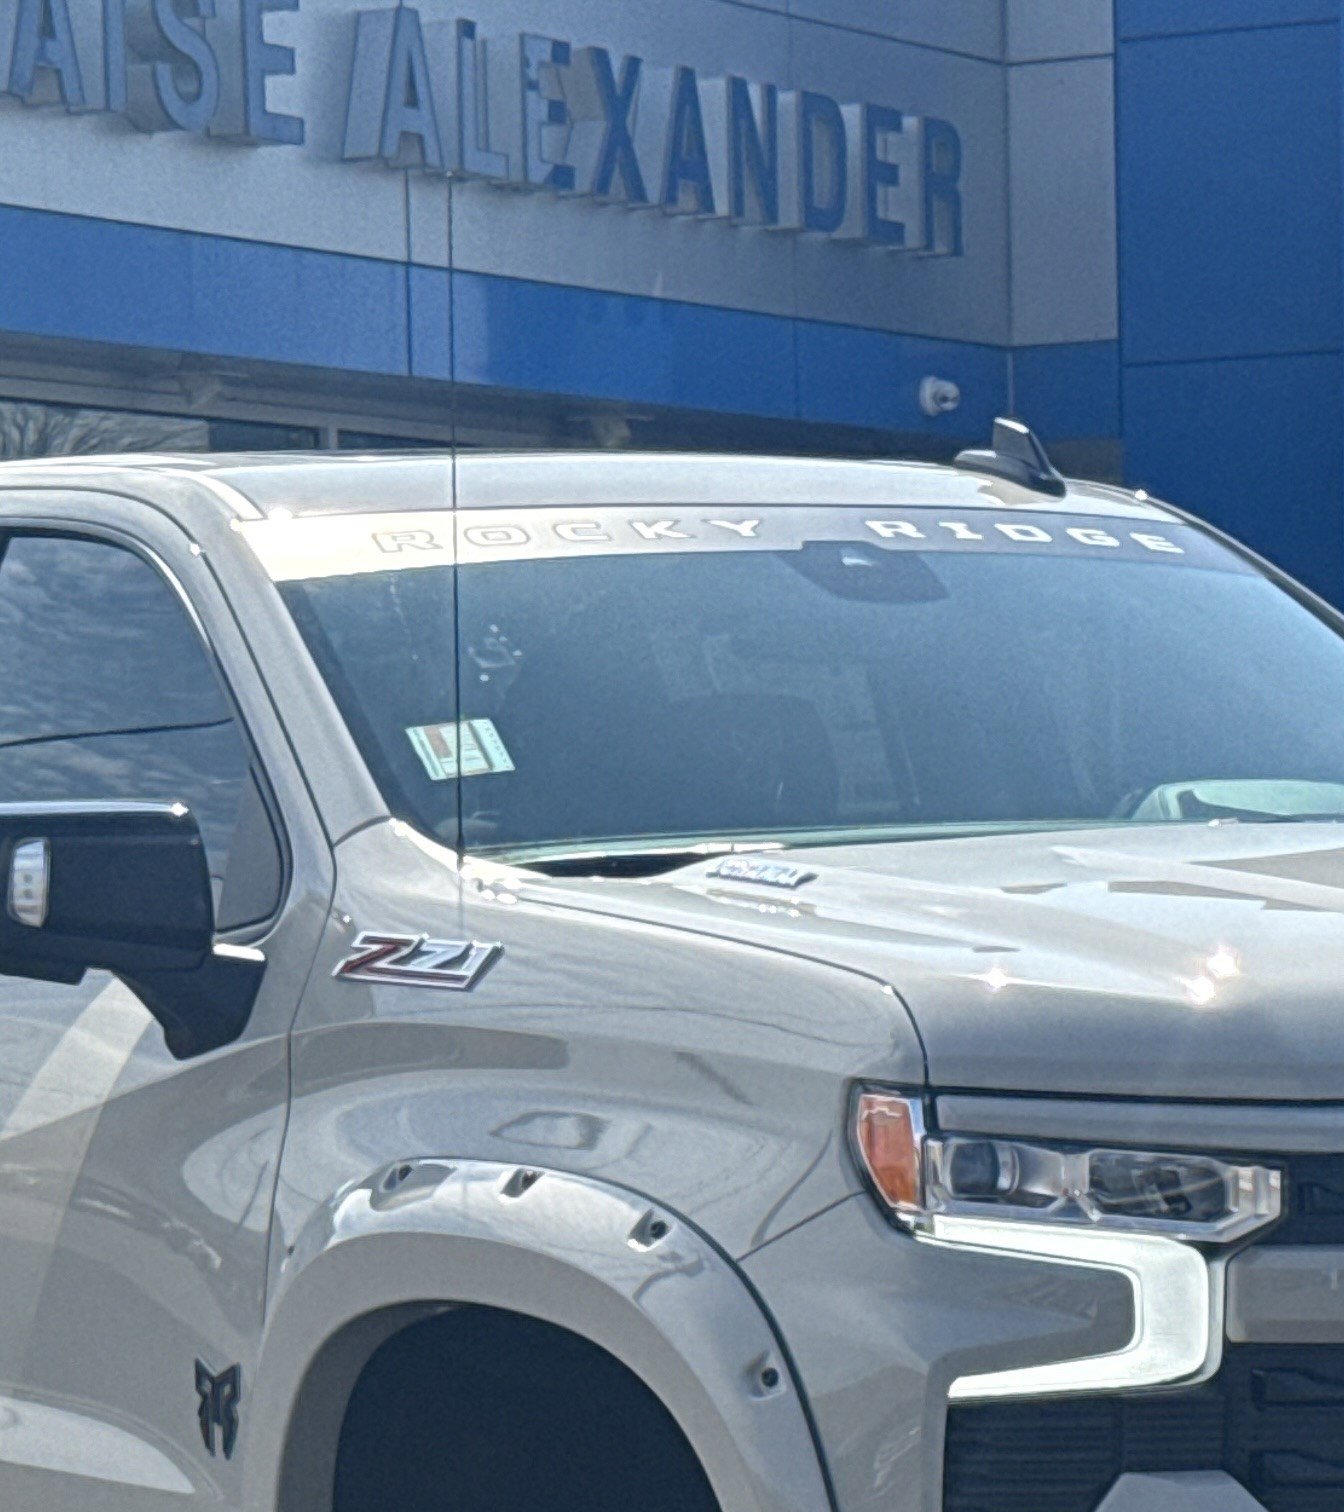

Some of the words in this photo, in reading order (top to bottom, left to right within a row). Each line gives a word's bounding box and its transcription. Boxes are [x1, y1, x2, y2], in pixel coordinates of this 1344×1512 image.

[351, 5, 964, 258] ALEXANDER
[372, 519, 760, 554] ROCKY
[864, 519, 1186, 554] RIDGE
[332, 931, 501, 990] Z71
